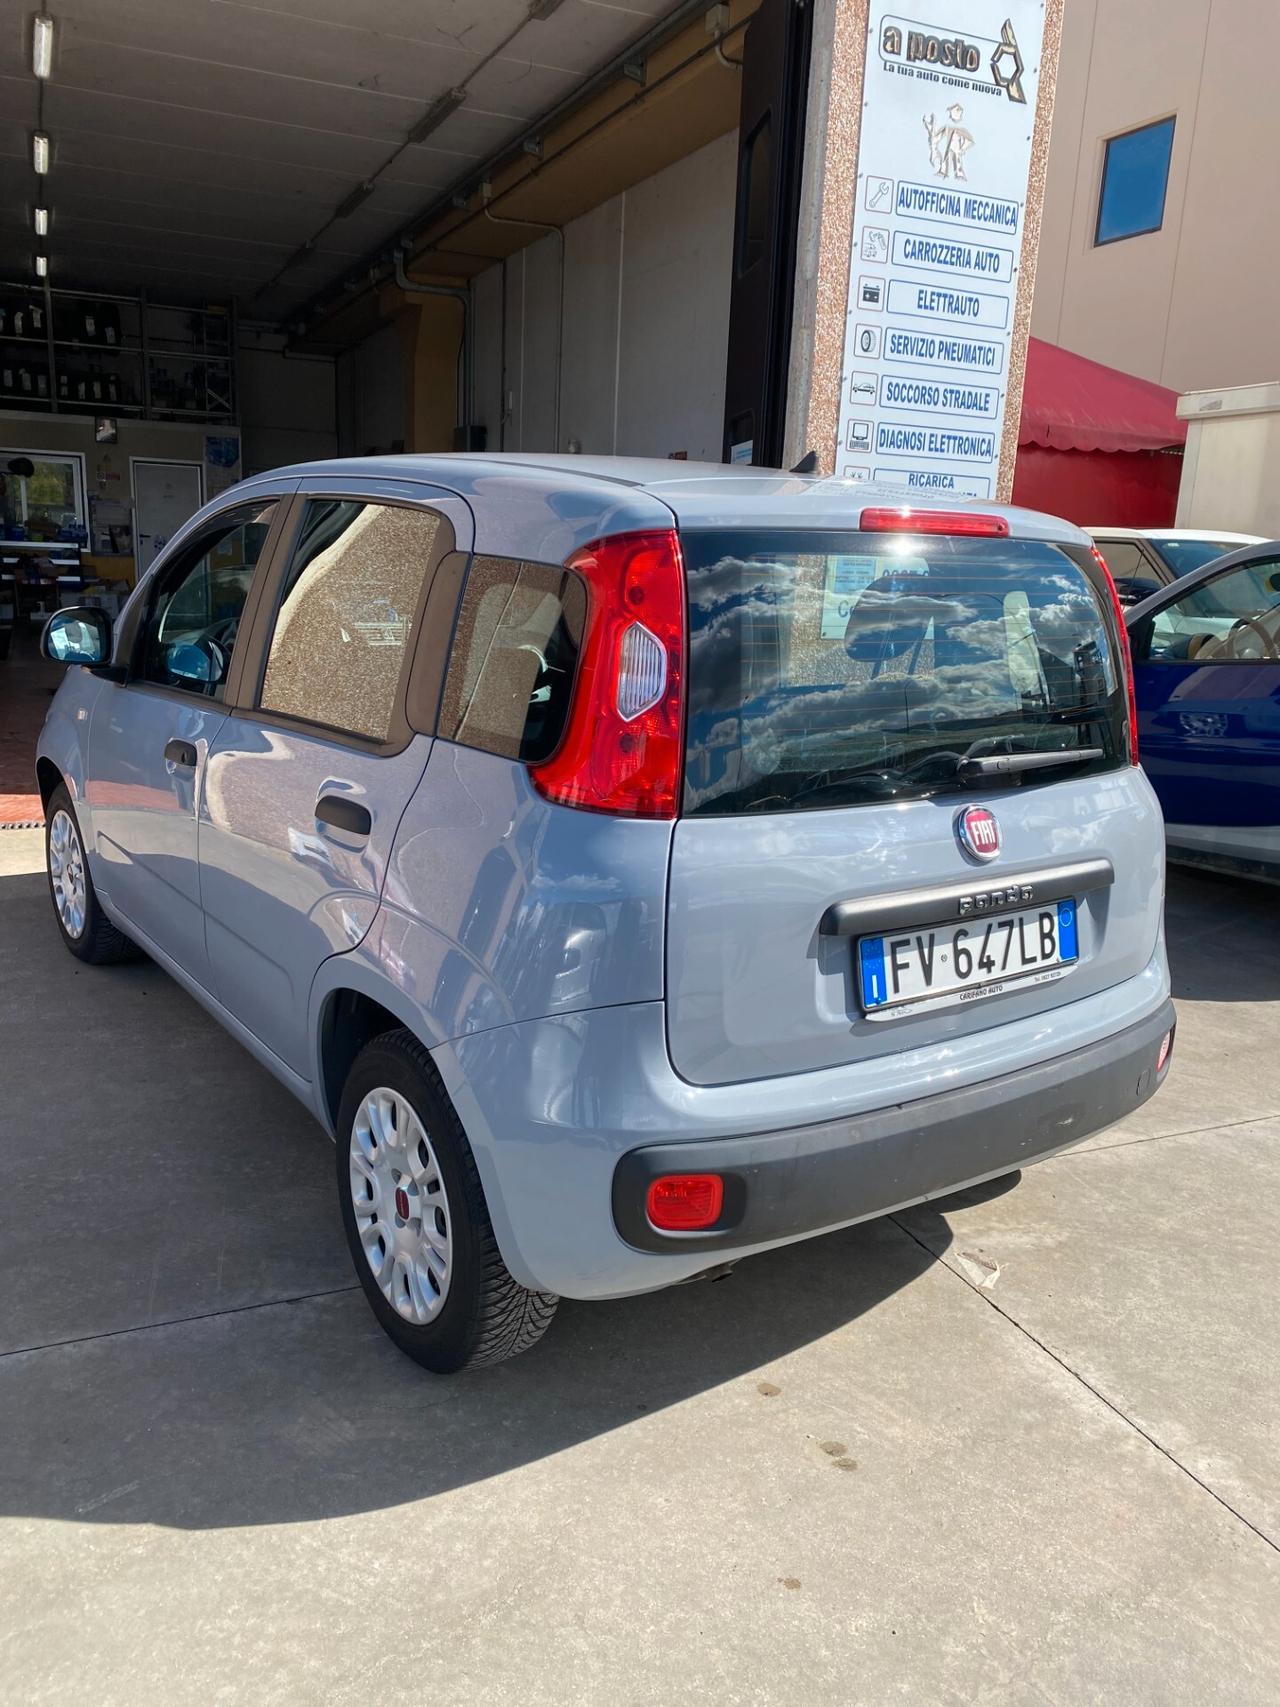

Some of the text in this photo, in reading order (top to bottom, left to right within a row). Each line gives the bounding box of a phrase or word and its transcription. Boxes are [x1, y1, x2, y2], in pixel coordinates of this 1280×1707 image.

[883, 26, 980, 73] a posto
[883, 61, 1002, 96] La tua auto come nuova
[899, 186, 1017, 227] AUTOFFICINA MECCANICA
[903, 238, 1001, 273] CARROZZERIA AUTO
[917, 289, 980, 317] ELETTRAUTO
[890, 334, 995, 366] SERVIZIO PNEUMATICI
[886, 382, 990, 412] SOCCORSO STRADALE
[879, 428, 992, 457] DIAGNOSI ELETTRONICA
[908, 472, 955, 490] RICARICA
[970, 819, 996, 846] FIAT
[890, 933, 936, 994] FV
